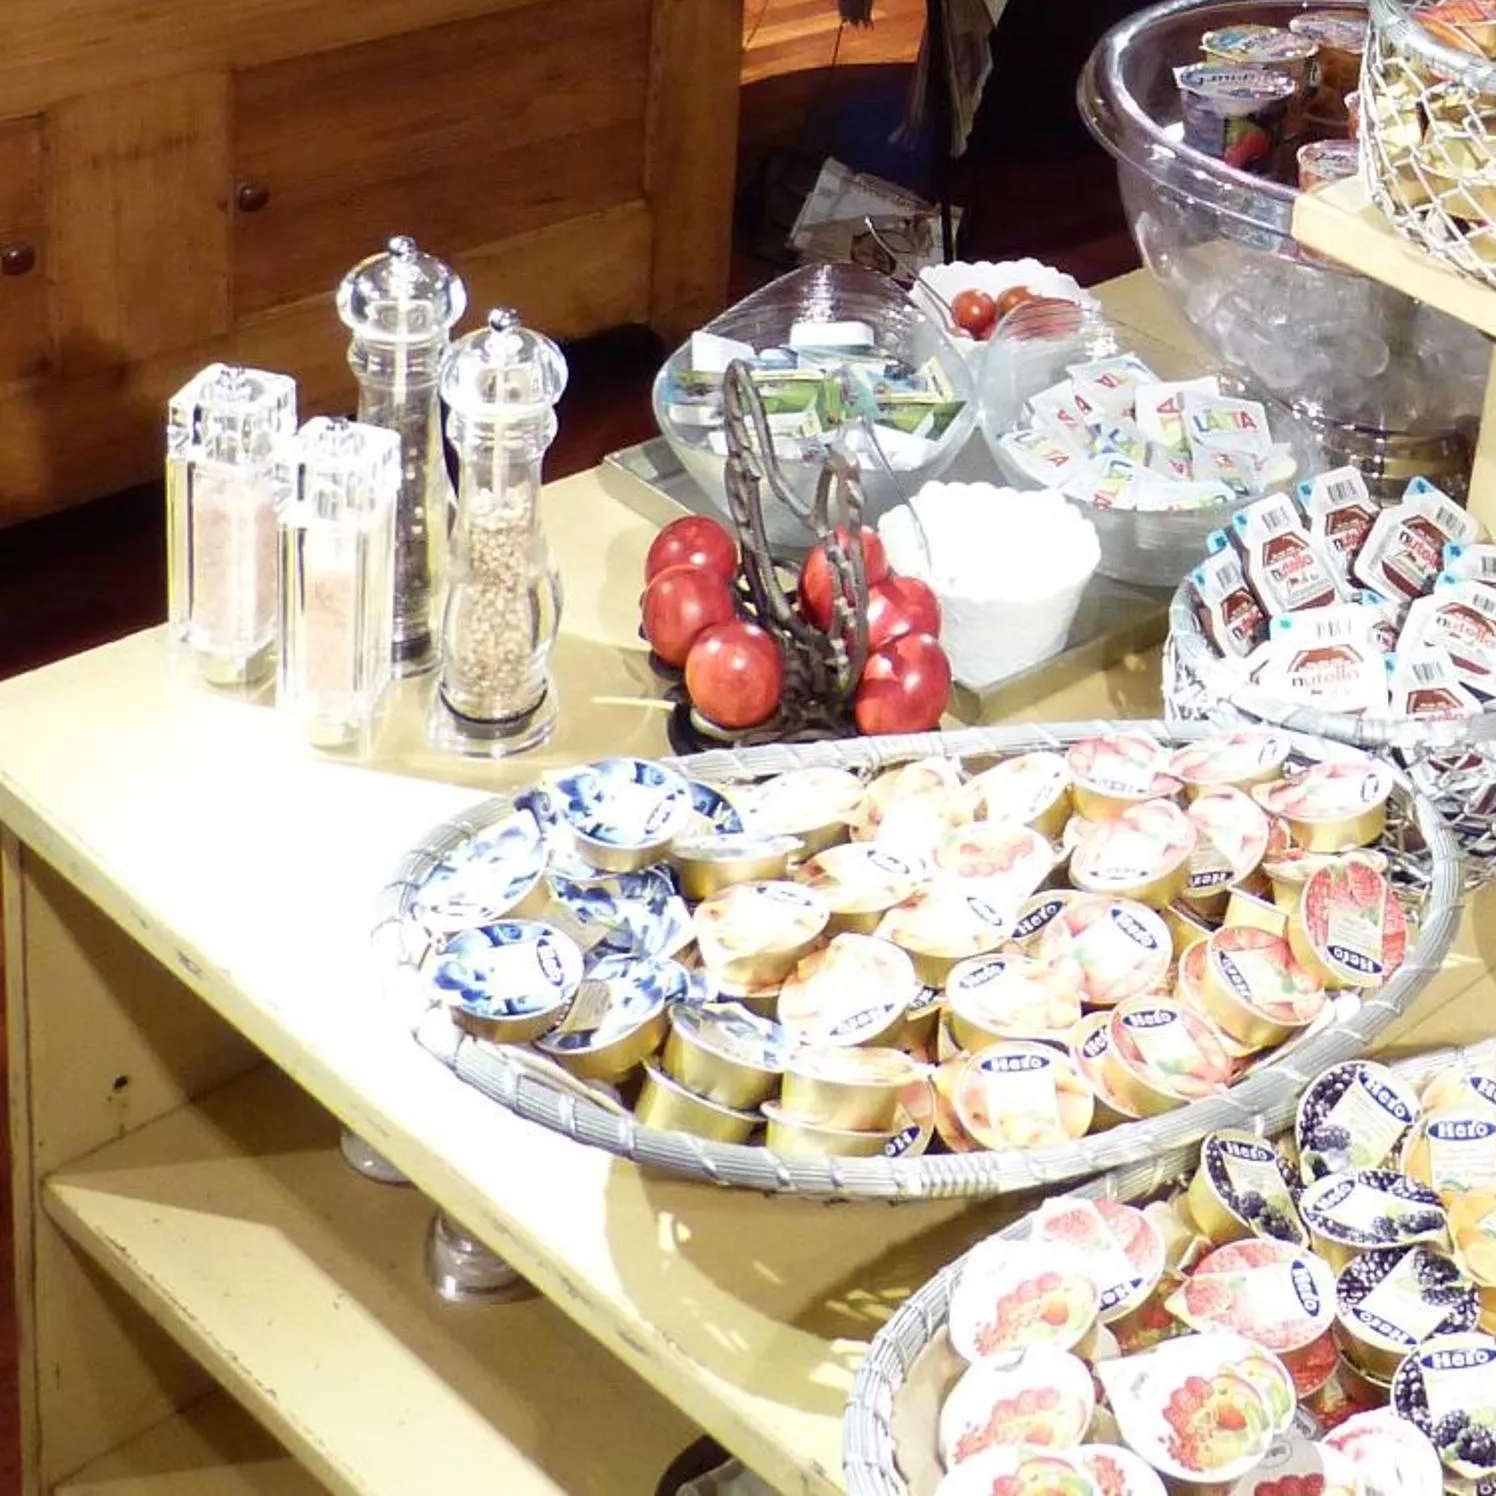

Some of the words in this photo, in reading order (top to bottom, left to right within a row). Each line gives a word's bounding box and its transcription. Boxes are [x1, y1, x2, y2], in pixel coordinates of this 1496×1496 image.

[1291, 664, 1360, 687] nutella
[1017, 902, 1059, 935] Hero
[1332, 947, 1376, 974] Hero
[1129, 1009, 1175, 1028] Hero
[987, 1054, 1044, 1073] Hero
[1436, 1120, 1490, 1140] Hero
[1226, 1141, 1267, 1161] Hero
[1431, 1347, 1489, 1367] Hero
